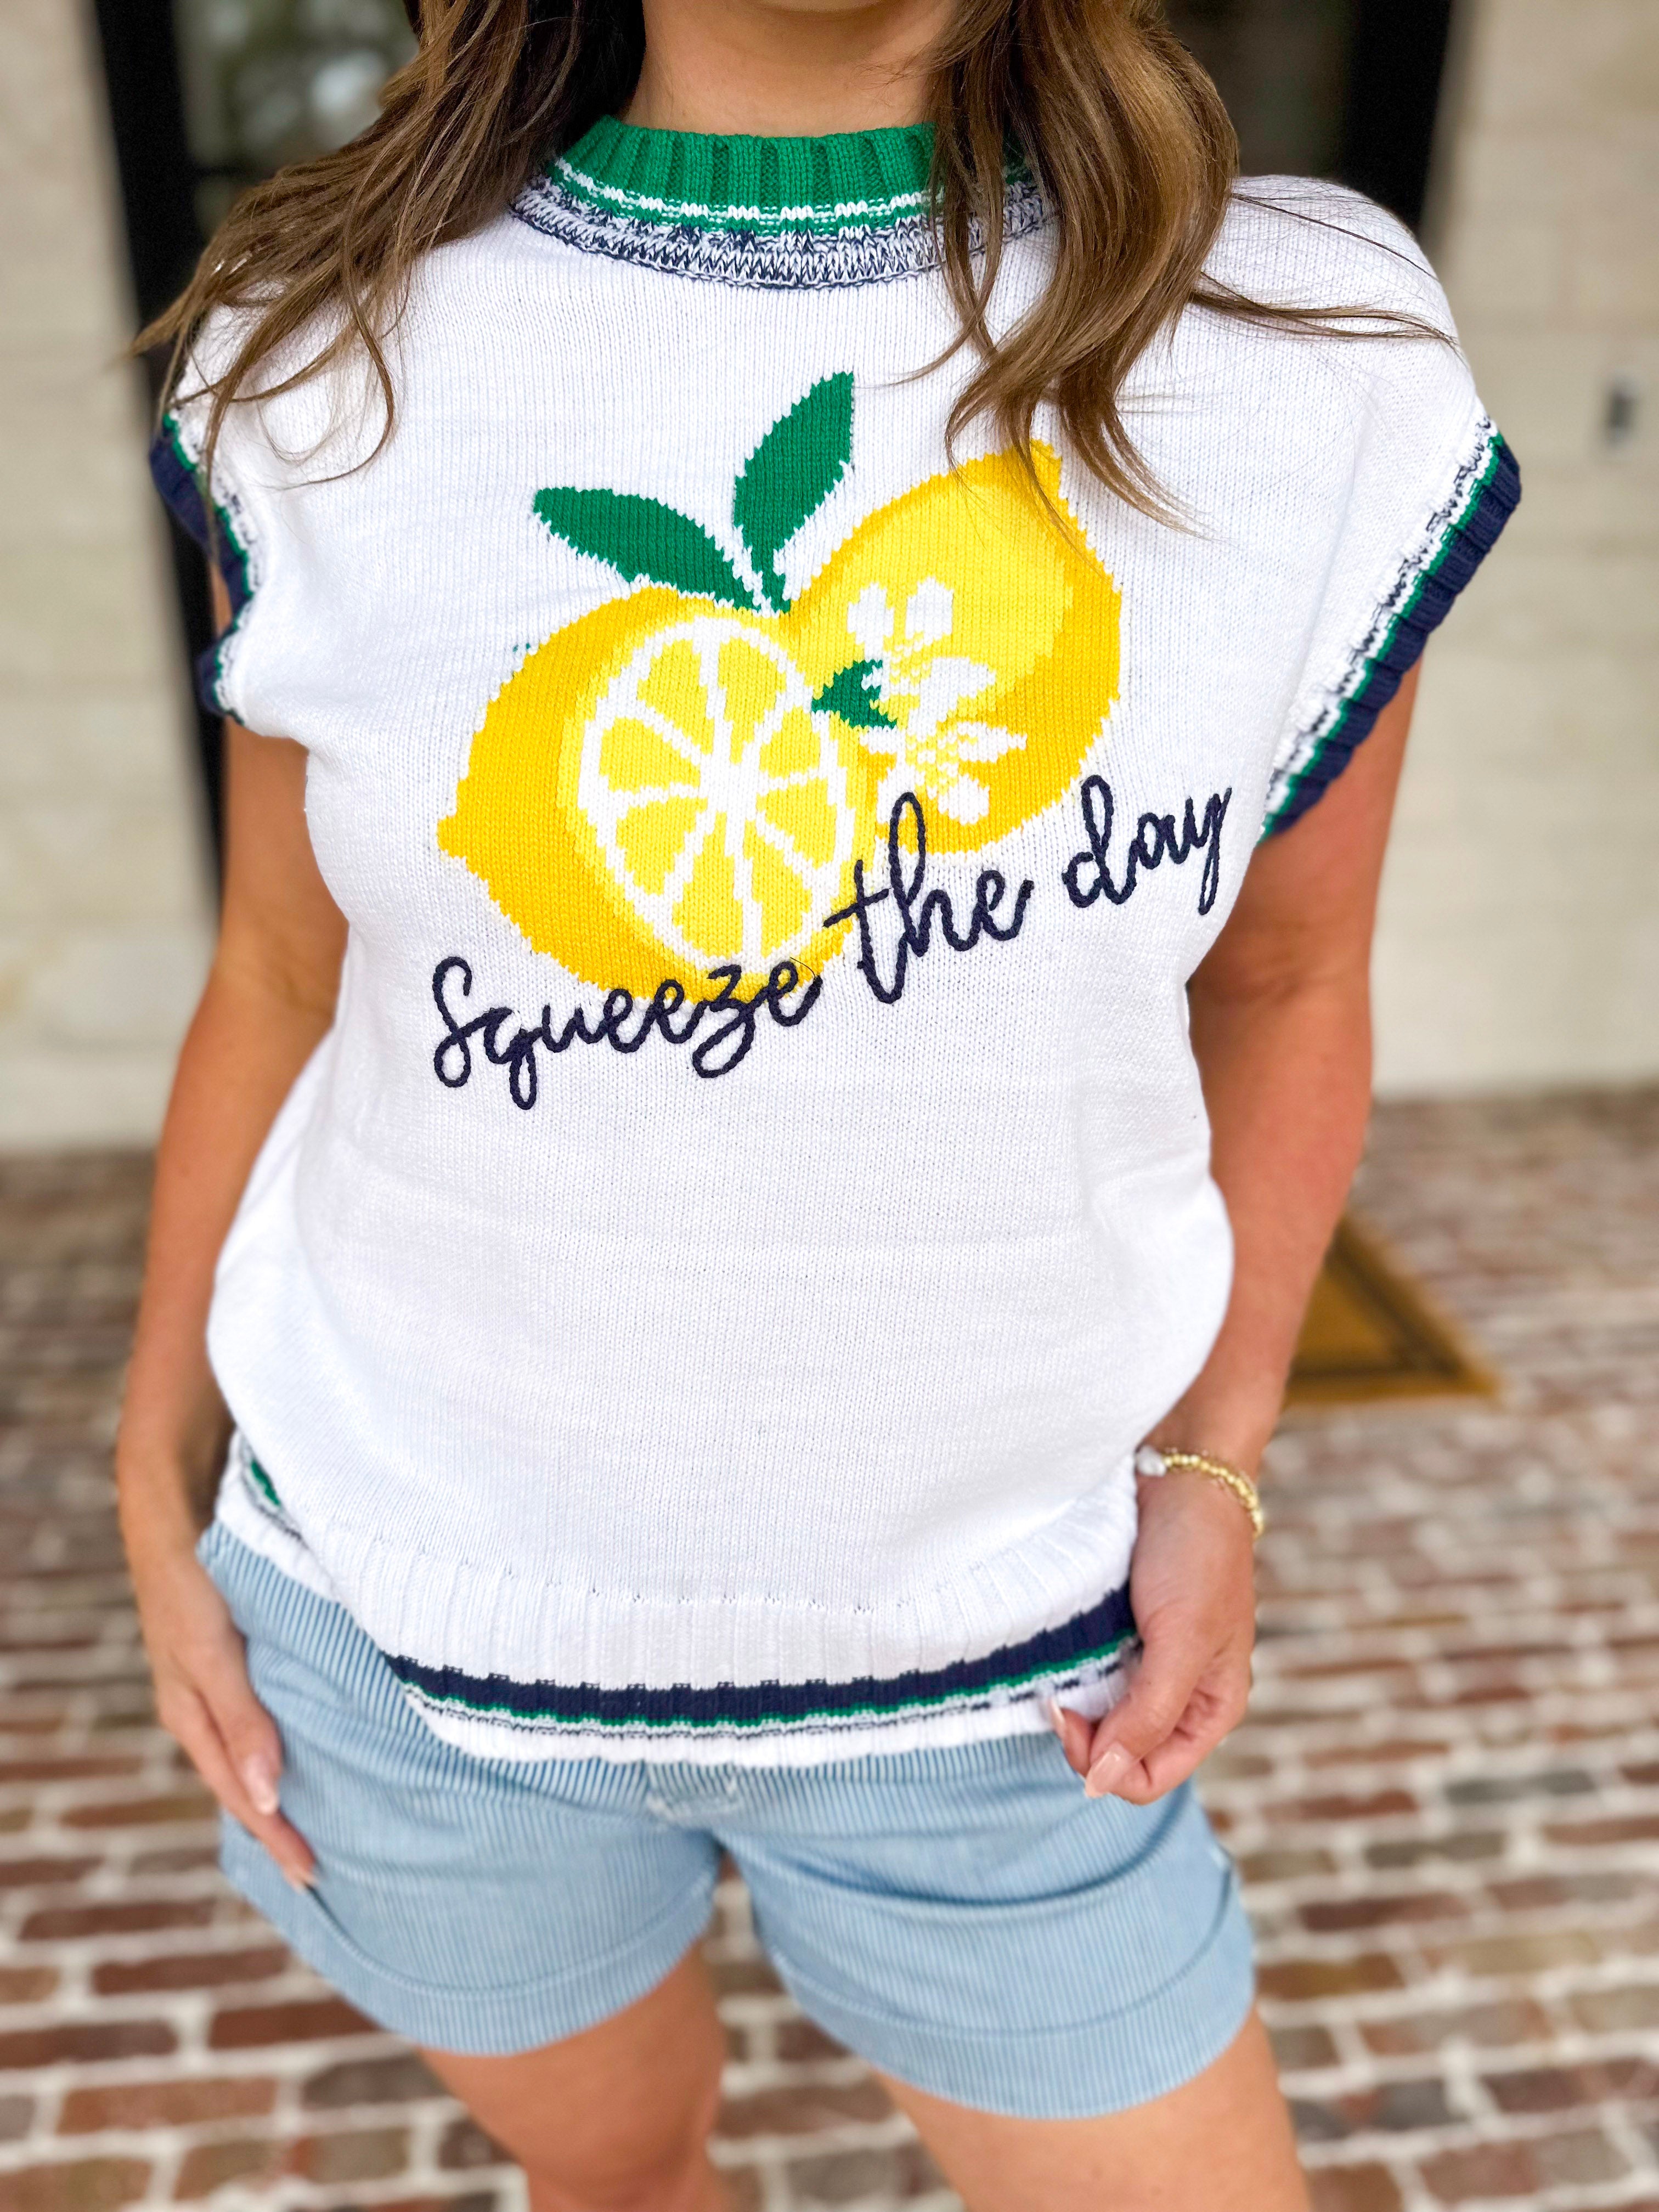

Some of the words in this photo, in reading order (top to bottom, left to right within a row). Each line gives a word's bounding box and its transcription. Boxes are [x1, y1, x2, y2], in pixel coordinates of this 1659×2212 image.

[432, 956, 823, 1110] Squeeze
[822, 792, 1035, 1005] the
[1061, 774, 1232, 916] day
